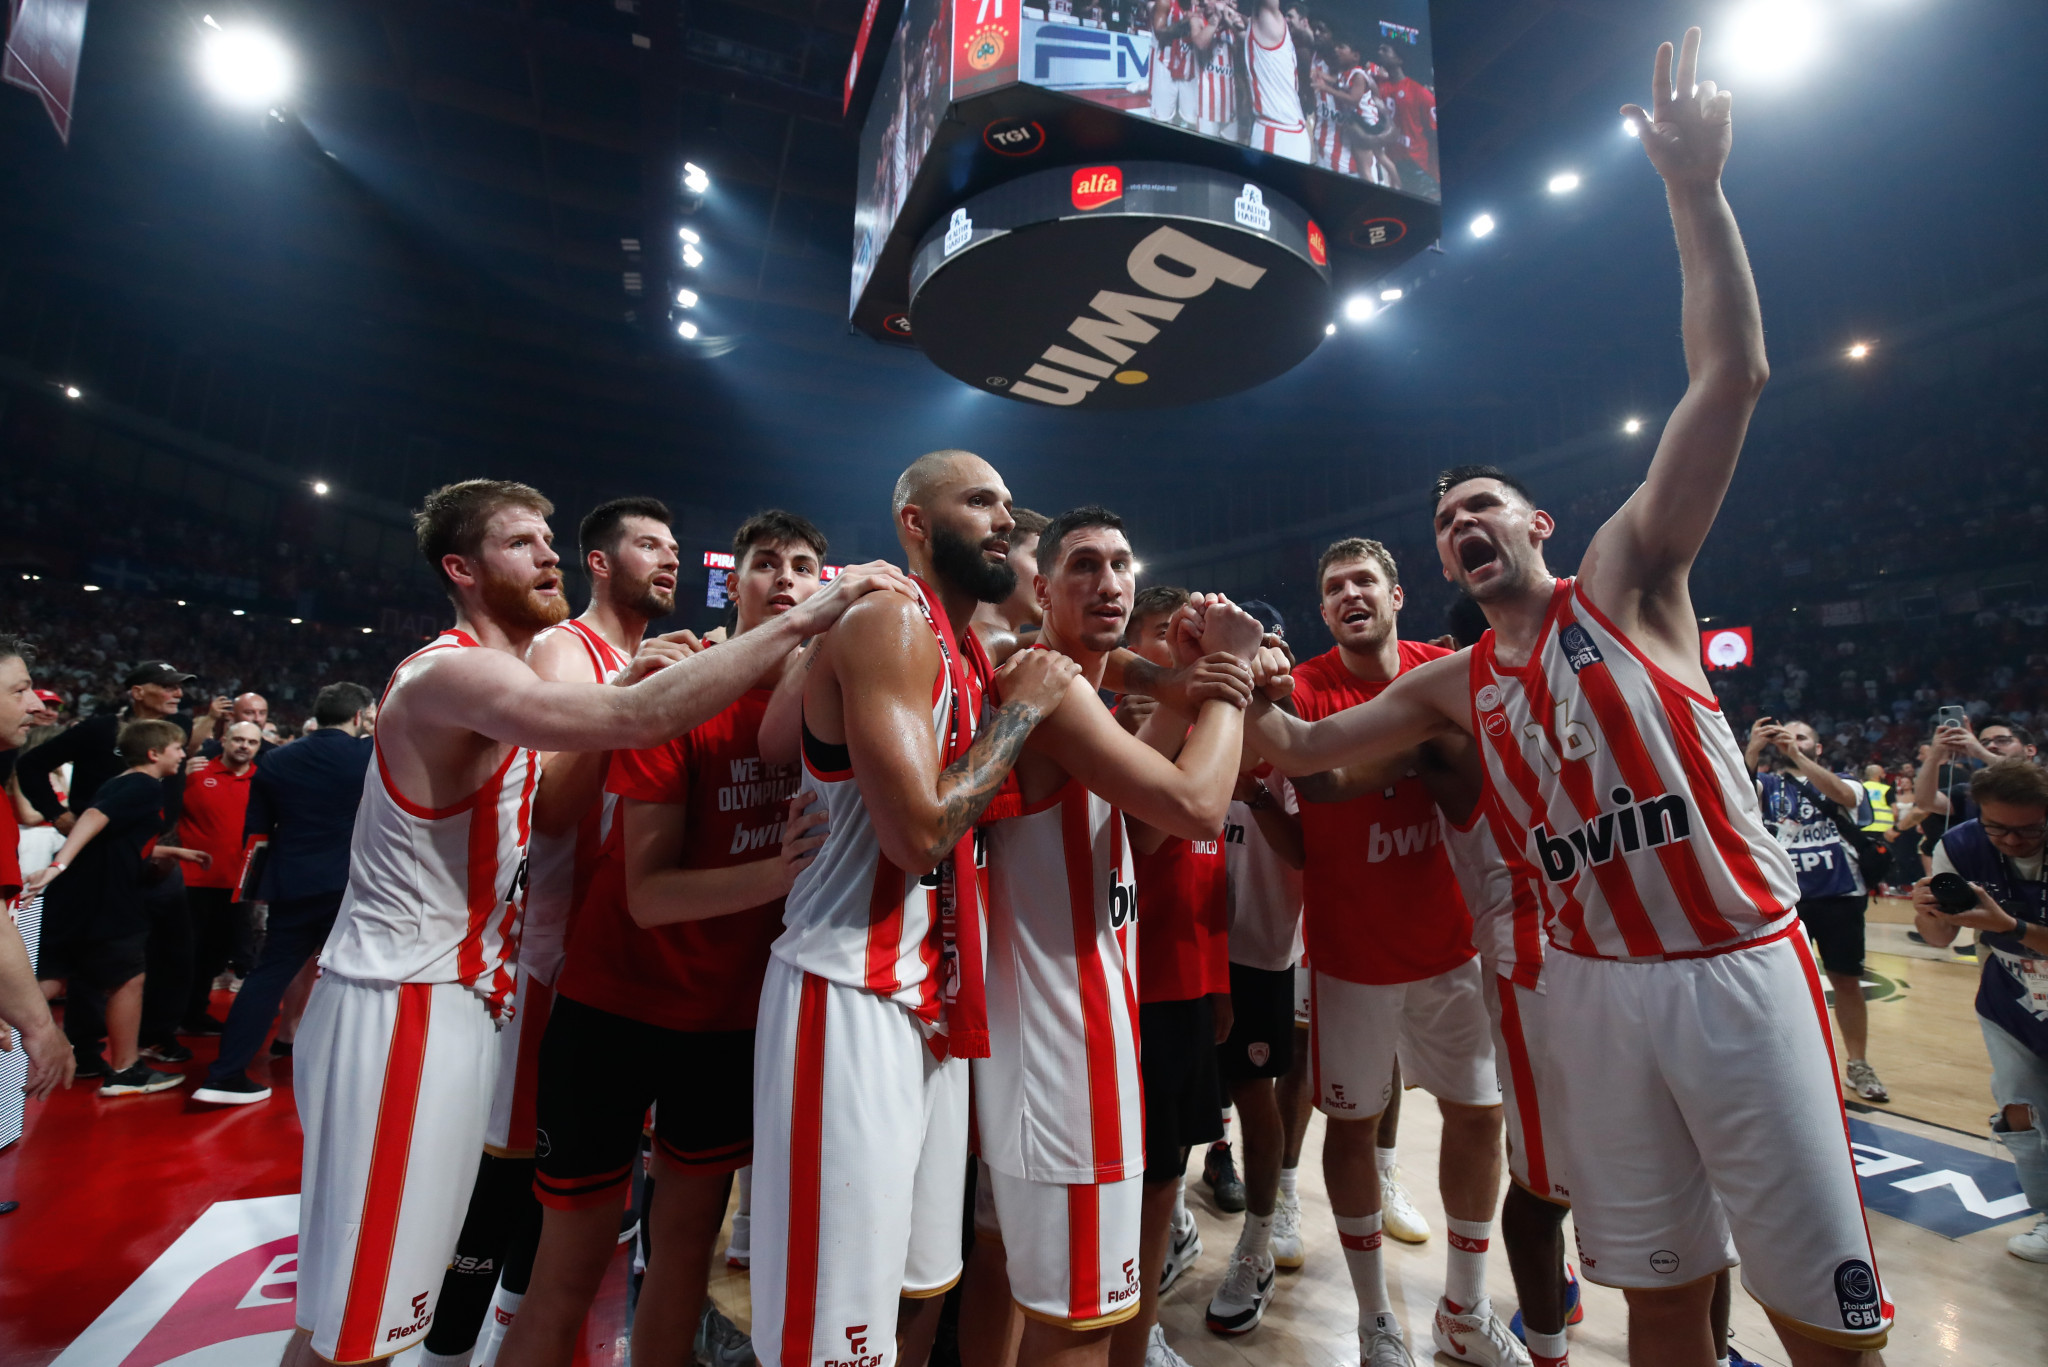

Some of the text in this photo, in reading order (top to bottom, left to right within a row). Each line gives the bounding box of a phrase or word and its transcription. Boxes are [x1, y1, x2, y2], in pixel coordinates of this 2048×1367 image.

[993, 126, 1030, 146] TGI
[1076, 173, 1118, 195] alfa
[1237, 201, 1266, 219] HEALTHY
[1237, 209, 1266, 228] HABITS
[1009, 225, 1268, 407] bwin
[1523, 699, 1597, 776] 16
[718, 776, 801, 812] OLYMPIACO
[1367, 803, 1443, 864] bwi
[1532, 784, 1691, 883] bwin
[1846, 1308, 1880, 1327] GBL
